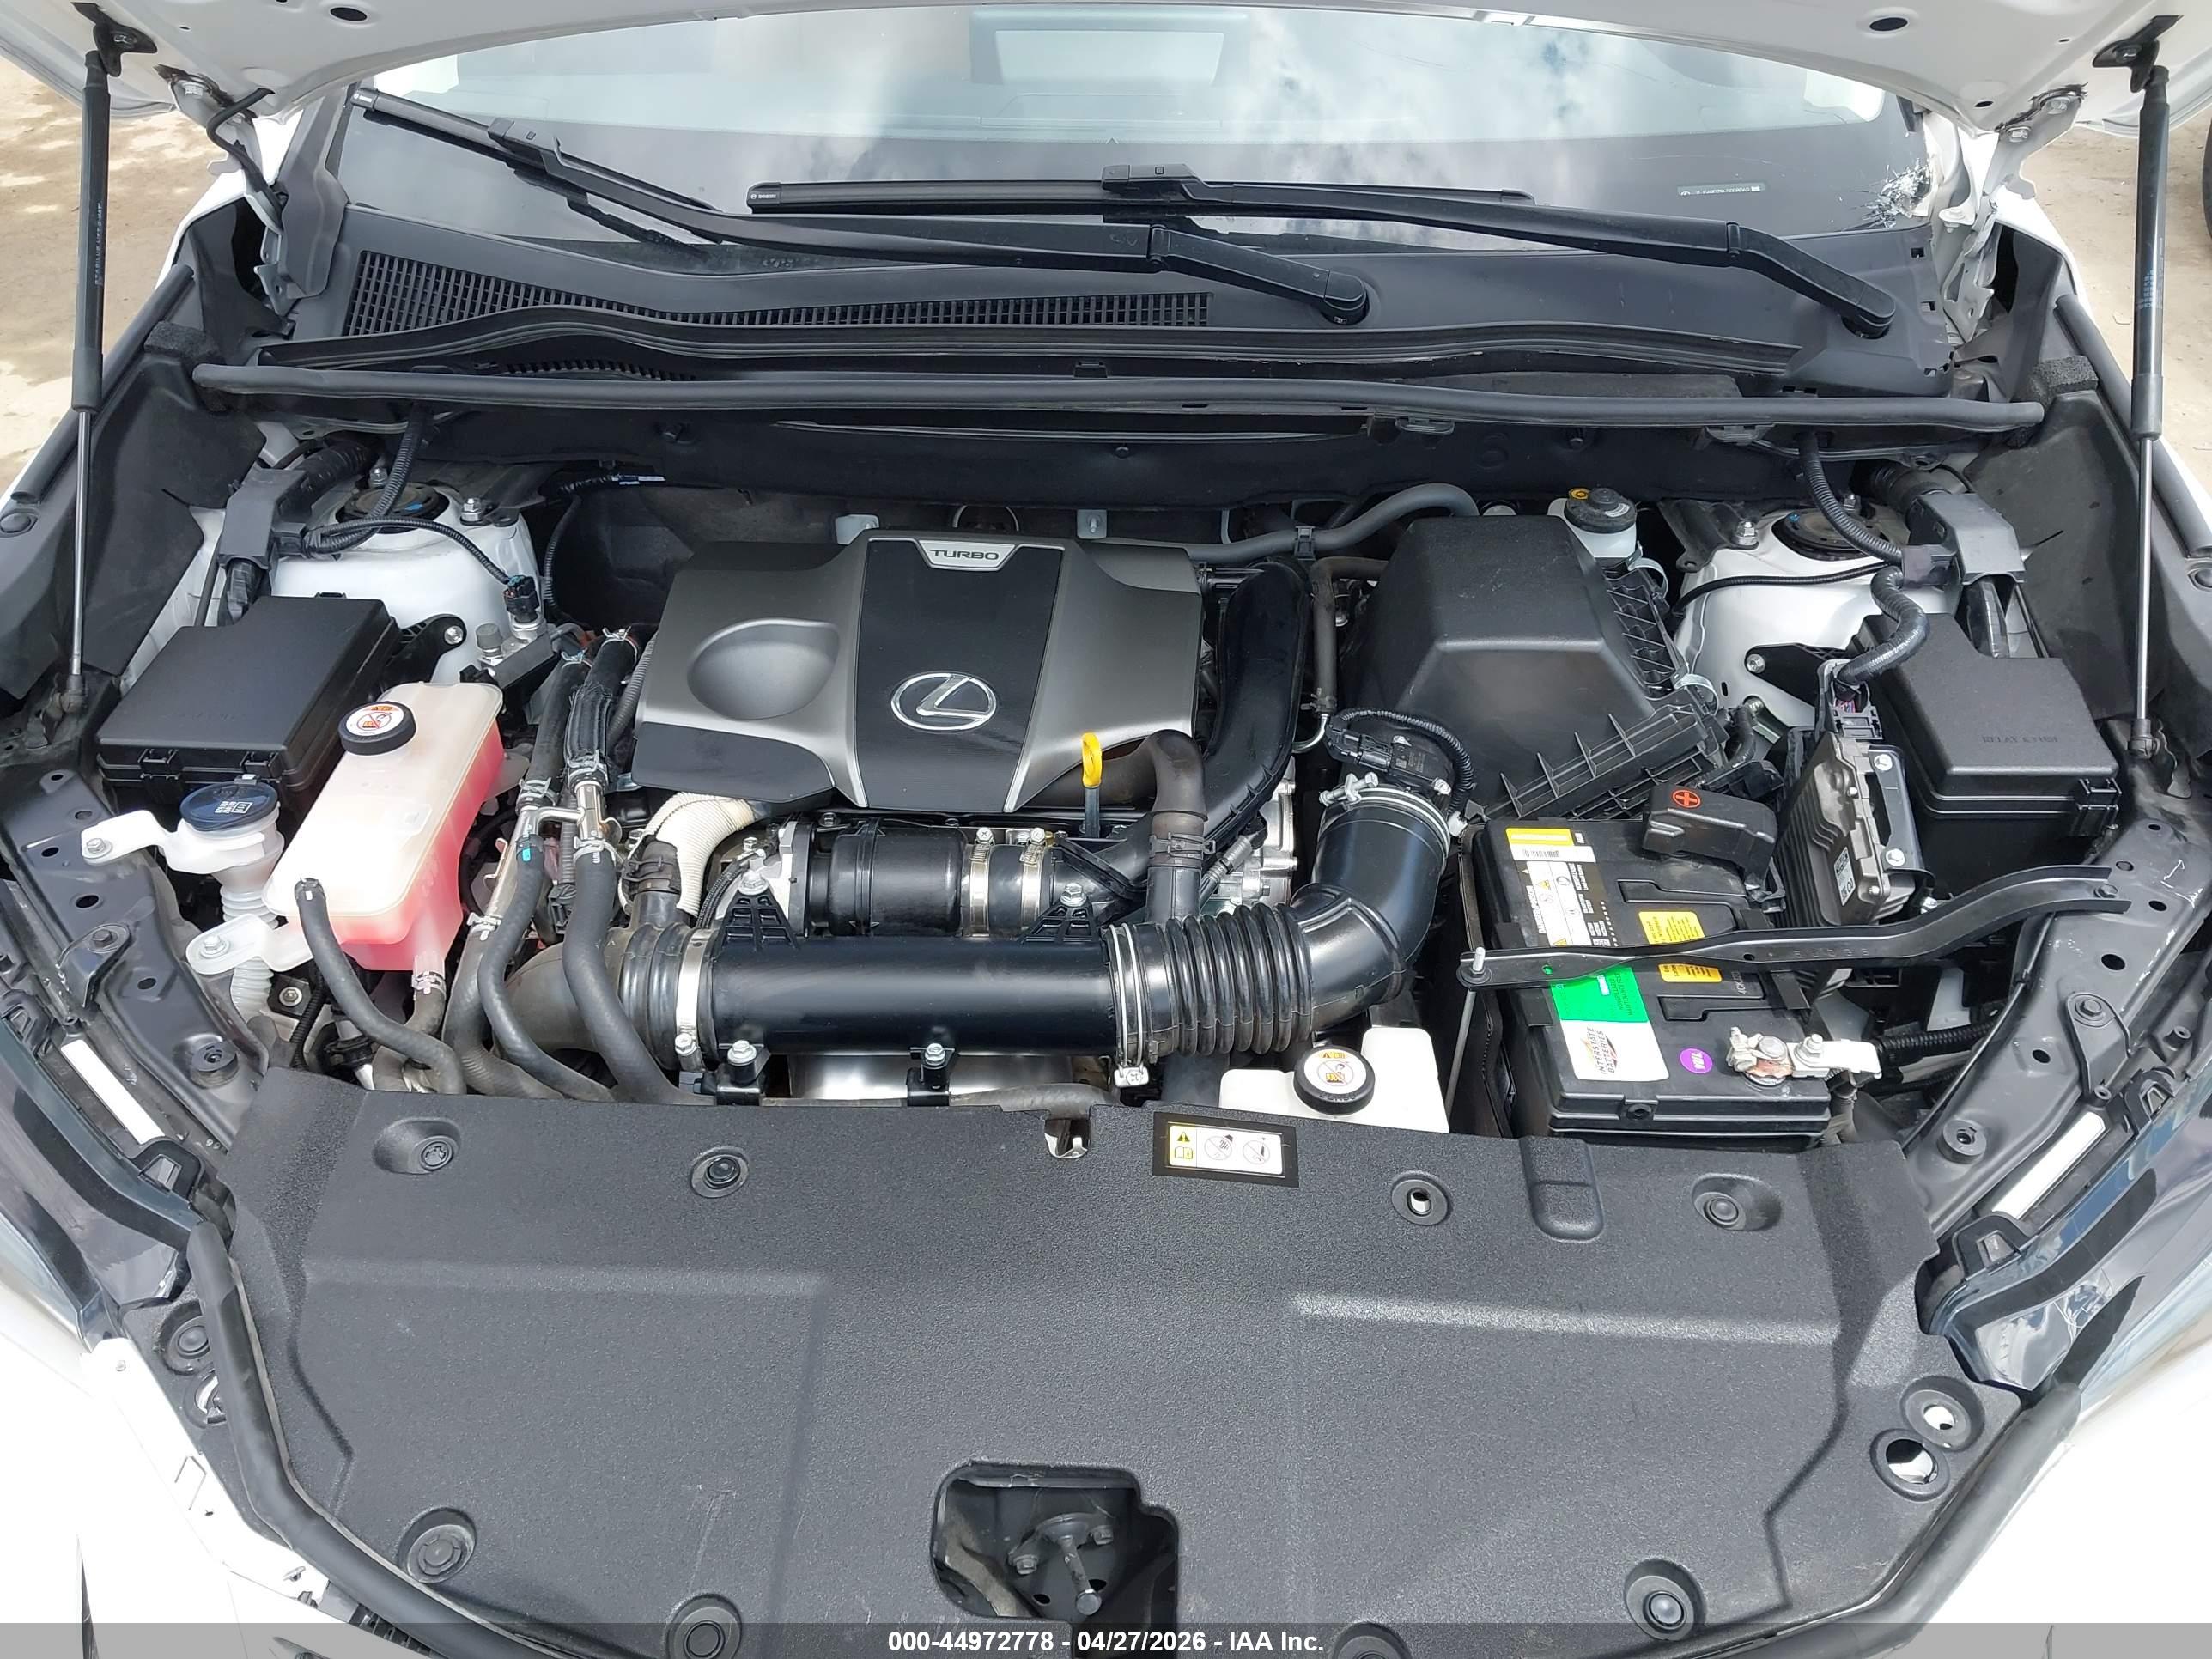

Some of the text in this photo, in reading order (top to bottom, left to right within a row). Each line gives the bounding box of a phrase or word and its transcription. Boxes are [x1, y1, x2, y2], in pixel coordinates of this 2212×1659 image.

[930, 549, 1000, 561] TURBO
[1586, 1025, 1608, 1075] INTERSTATE
[1596, 1030, 1617, 1074] BATTERIES
